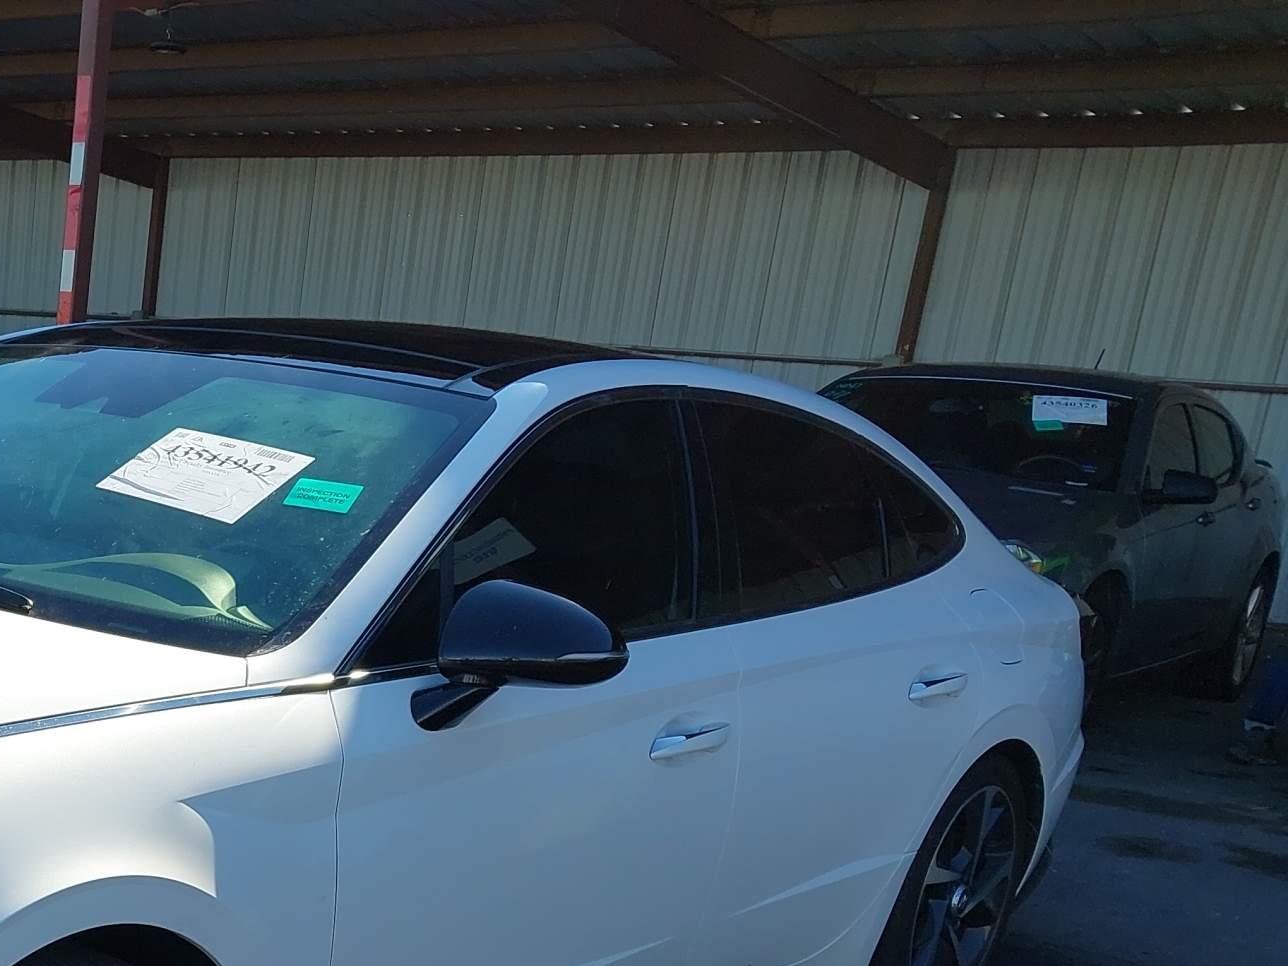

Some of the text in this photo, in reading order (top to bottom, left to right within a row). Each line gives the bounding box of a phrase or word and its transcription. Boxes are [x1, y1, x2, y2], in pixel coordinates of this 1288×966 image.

[166, 443, 278, 478] 43541942
[296, 486, 351, 499] INSPECTION
[296, 492, 345, 504] COMPLETE
